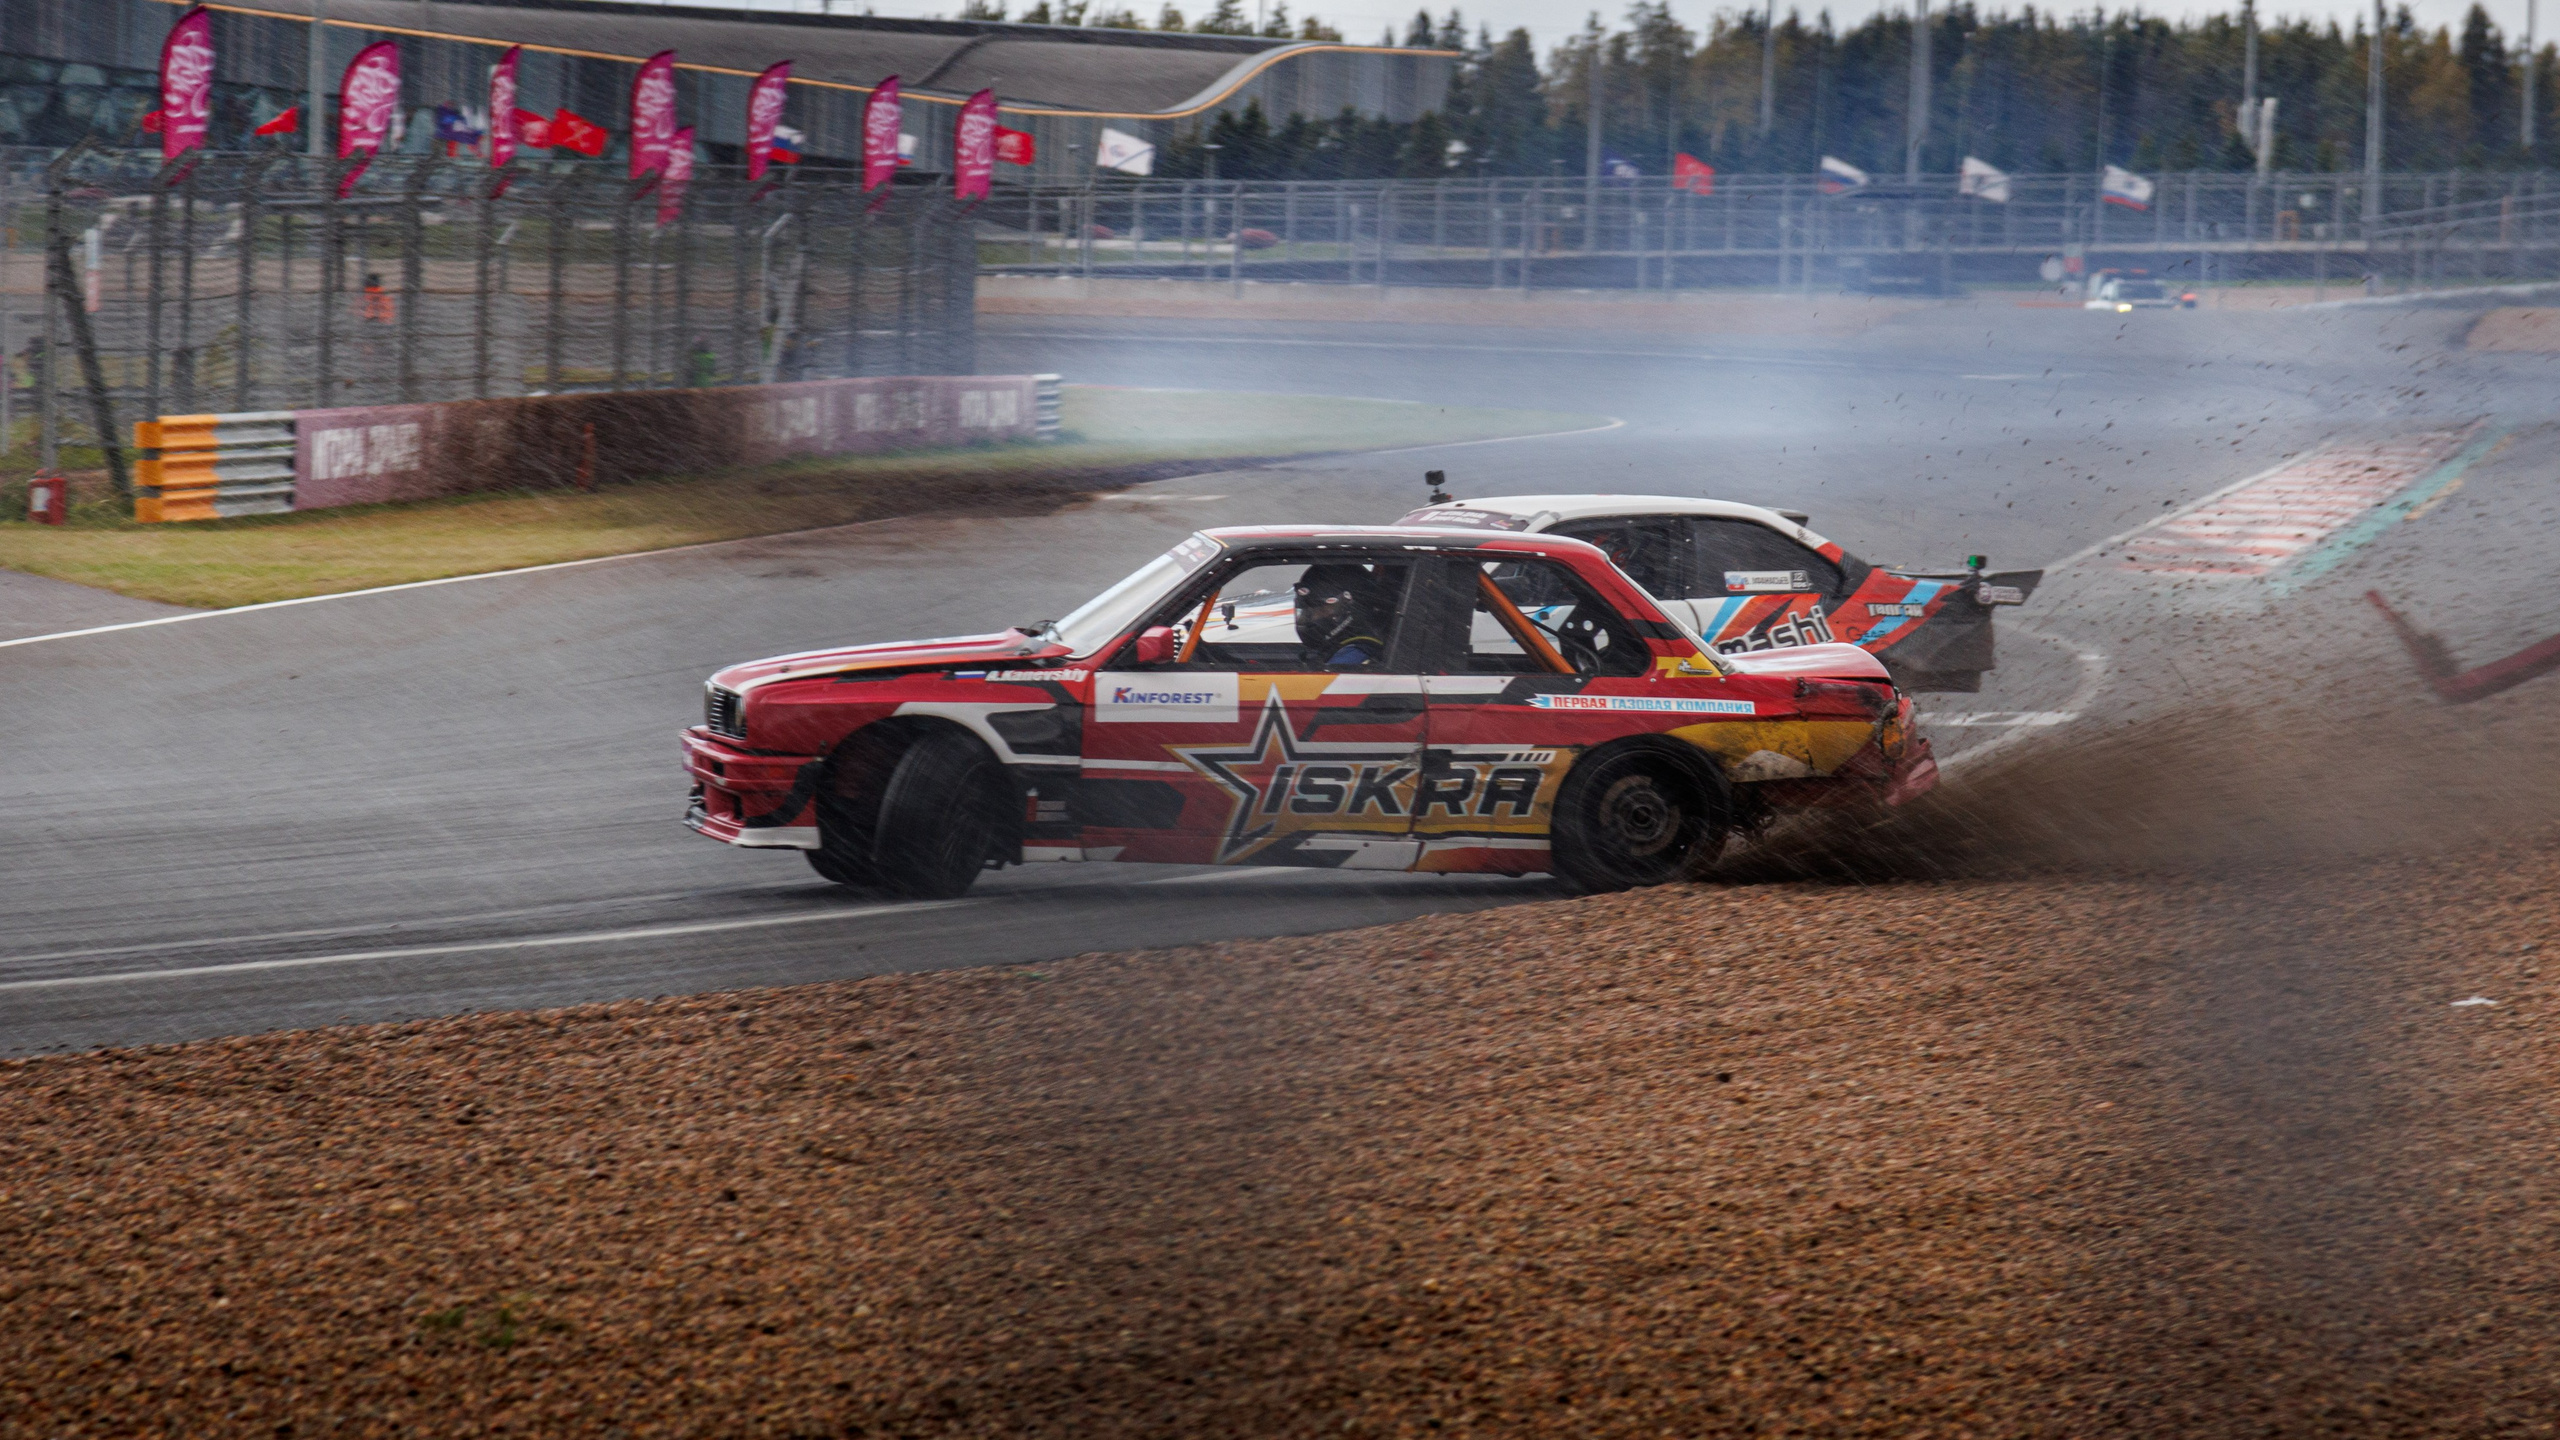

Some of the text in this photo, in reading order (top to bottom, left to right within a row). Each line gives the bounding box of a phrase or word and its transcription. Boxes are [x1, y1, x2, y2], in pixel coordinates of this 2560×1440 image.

[1112, 687, 1213, 704] KINFOREST
[1553, 697, 1752, 713] ПЕРВАЯ ГАЗОВАЯ КОМПАНИЯ
[1261, 763, 1544, 816] ISKRA
